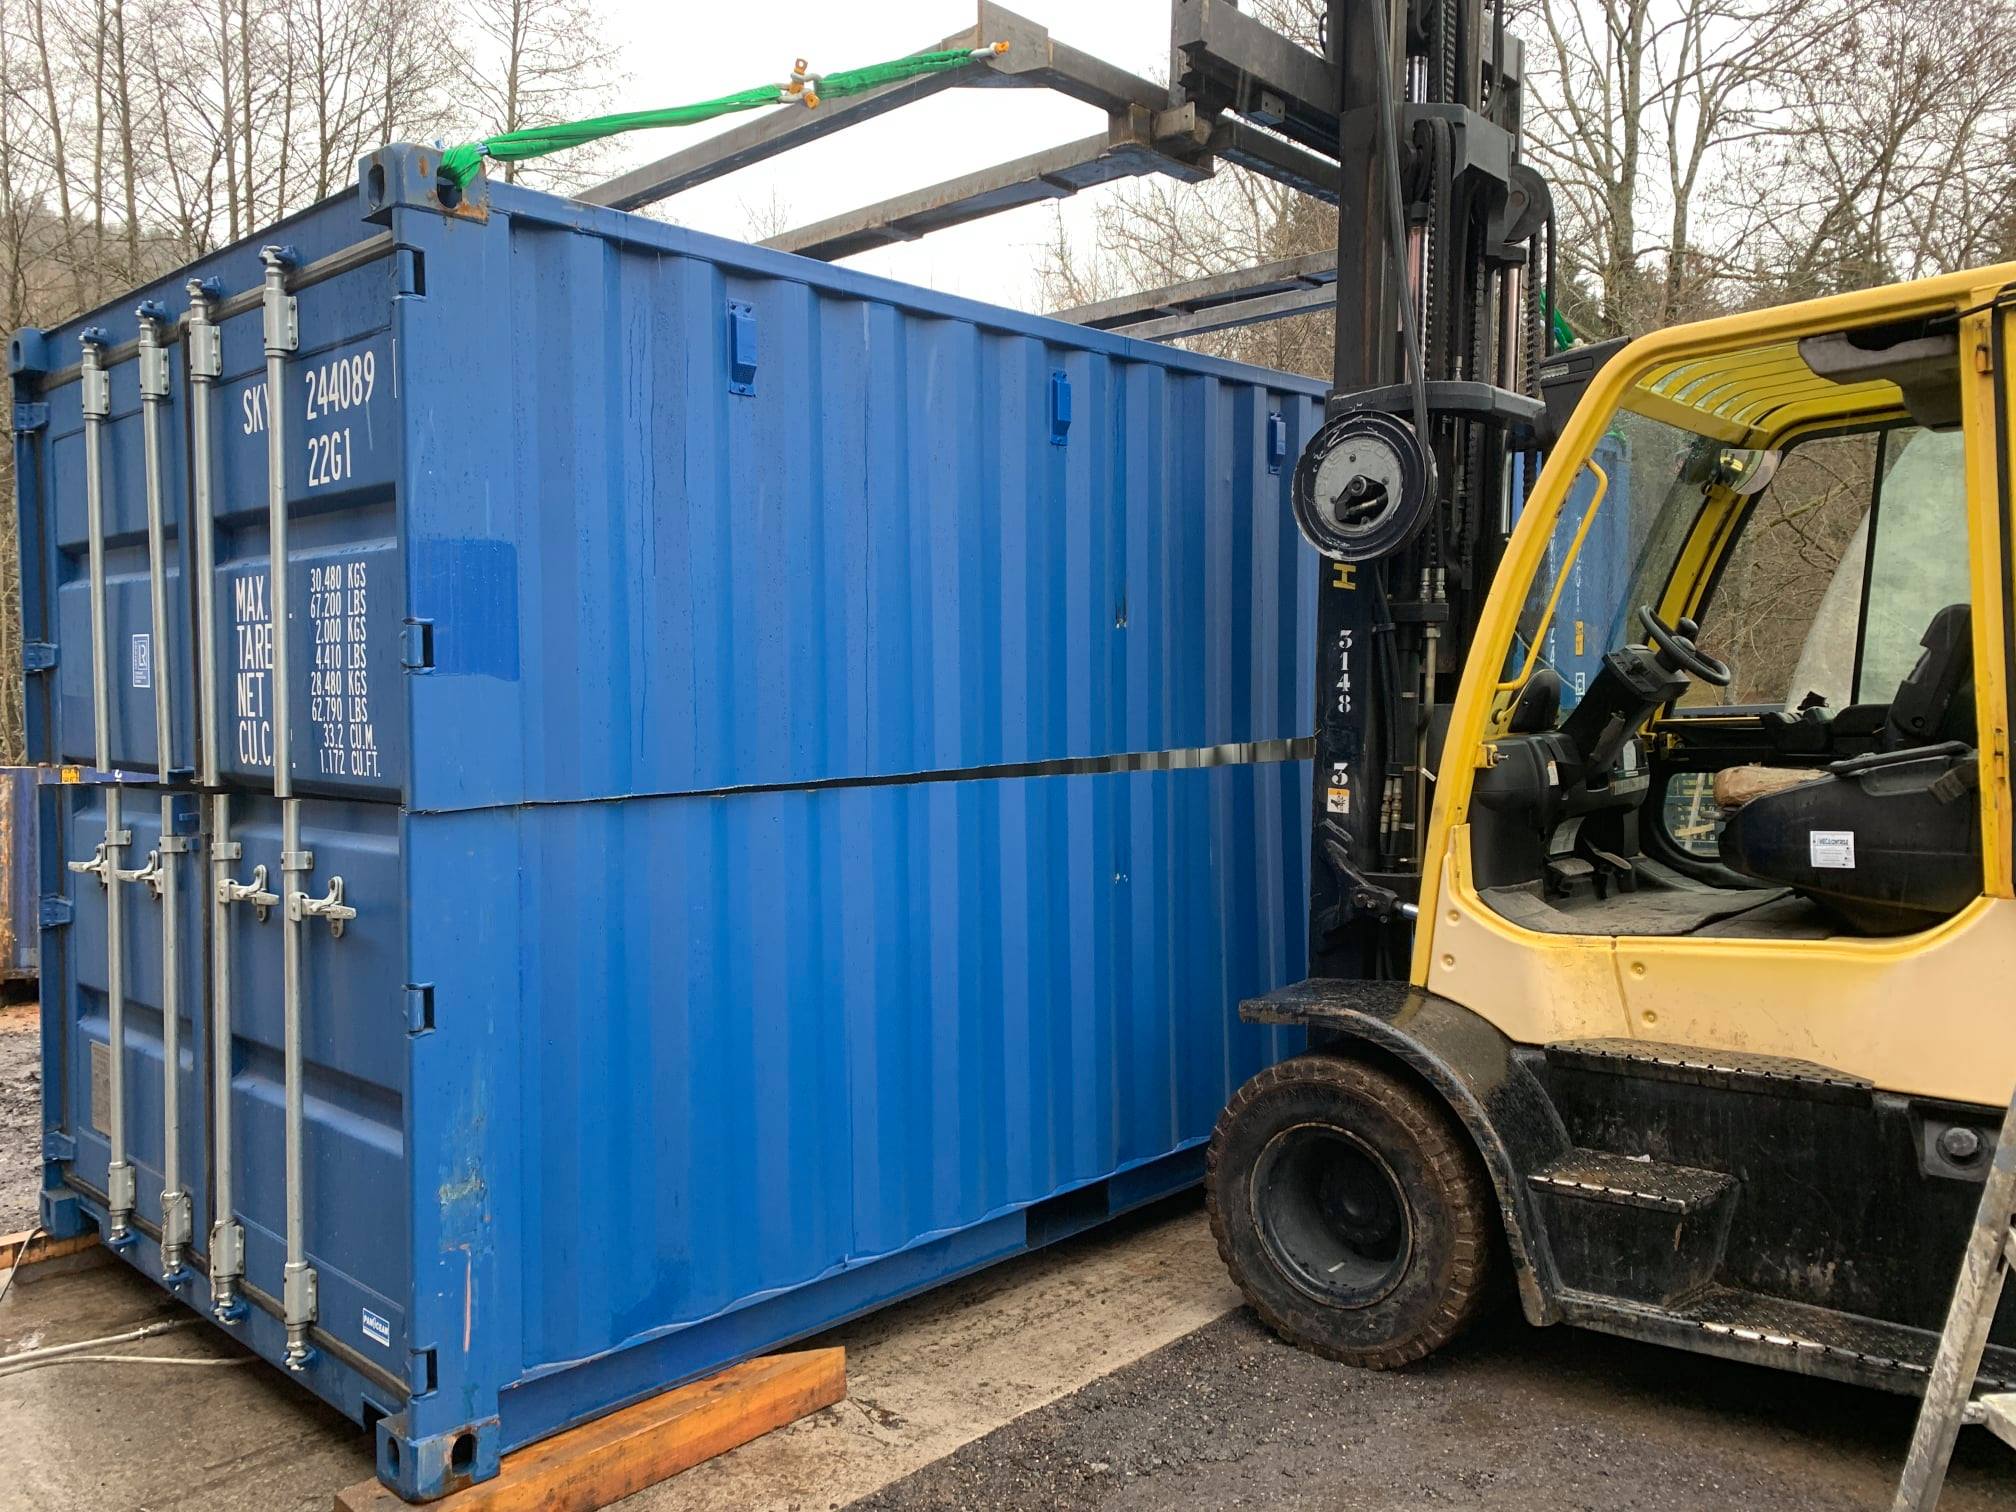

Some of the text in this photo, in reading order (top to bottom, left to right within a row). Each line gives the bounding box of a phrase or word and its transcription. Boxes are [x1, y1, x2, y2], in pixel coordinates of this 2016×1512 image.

[305, 350, 375, 420] 244089
[308, 427, 351, 487] 22G1
[347, 562, 366, 589] KGS
[347, 589, 367, 615] LBS
[347, 616, 367, 642] KGS
[237, 623, 273, 670] TARE
[347, 643, 367, 669] LBS
[237, 672, 265, 718] NET
[348, 670, 368, 696] KGS
[348, 697, 368, 722] LBS
[323, 723, 344, 749] 33.2
